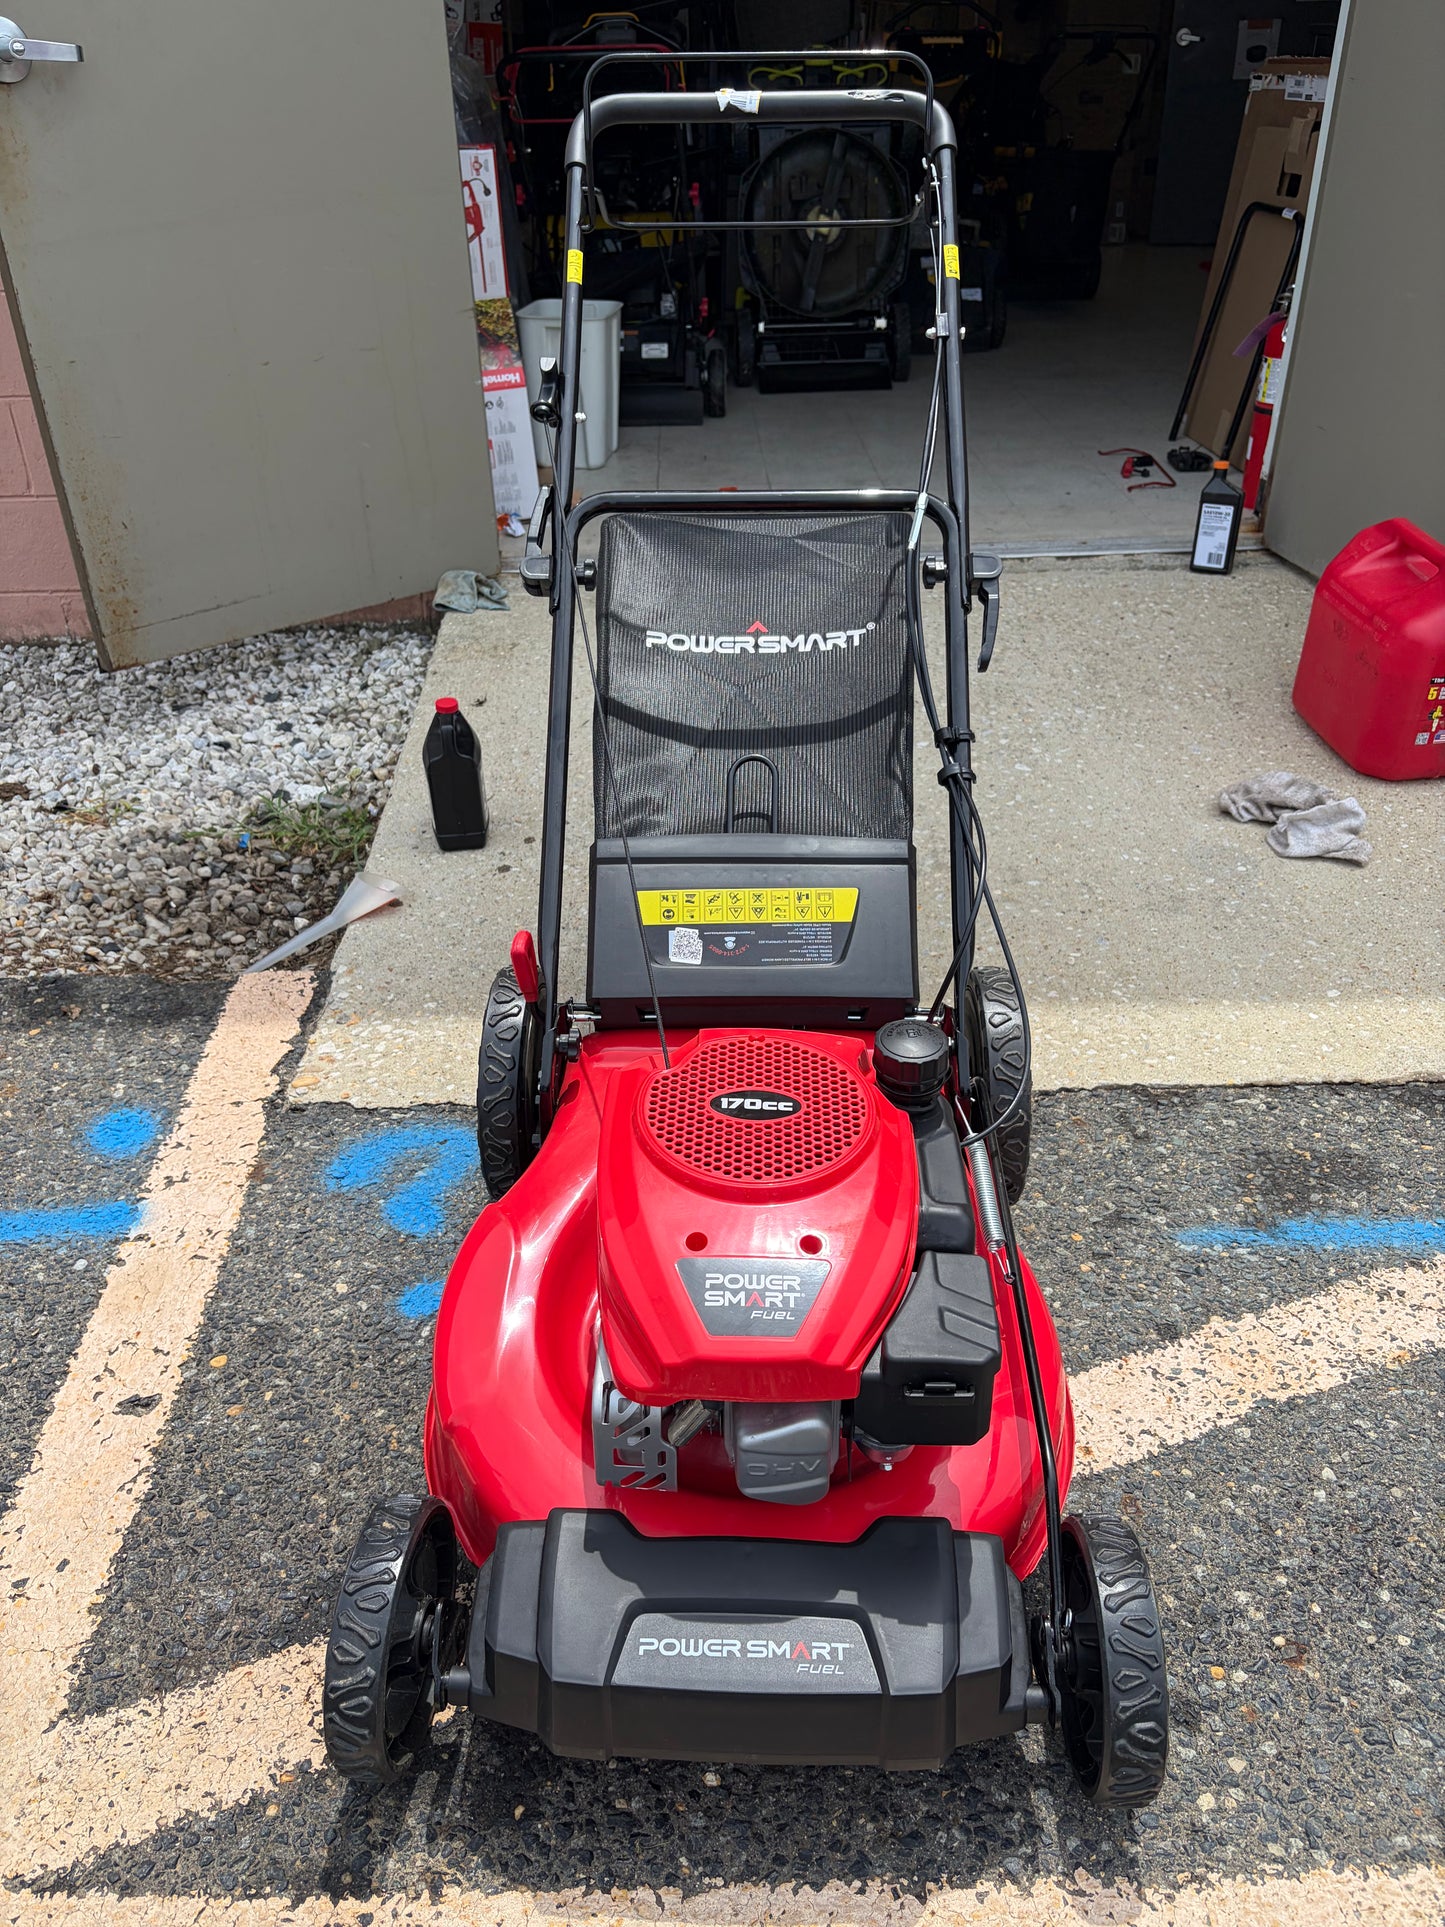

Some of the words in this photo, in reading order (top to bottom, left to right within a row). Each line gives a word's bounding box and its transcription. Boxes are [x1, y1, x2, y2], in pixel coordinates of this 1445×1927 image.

[720, 1097, 793, 1112] 170cc
[704, 1273, 801, 1291] POWER
[704, 1291, 801, 1308] SMART
[750, 1310, 795, 1320] FUEL
[747, 1459, 821, 1477] OHV
[638, 1638, 741, 1658] POWER
[747, 1640, 850, 1661] SMART
[796, 1663, 845, 1675] FUEL
